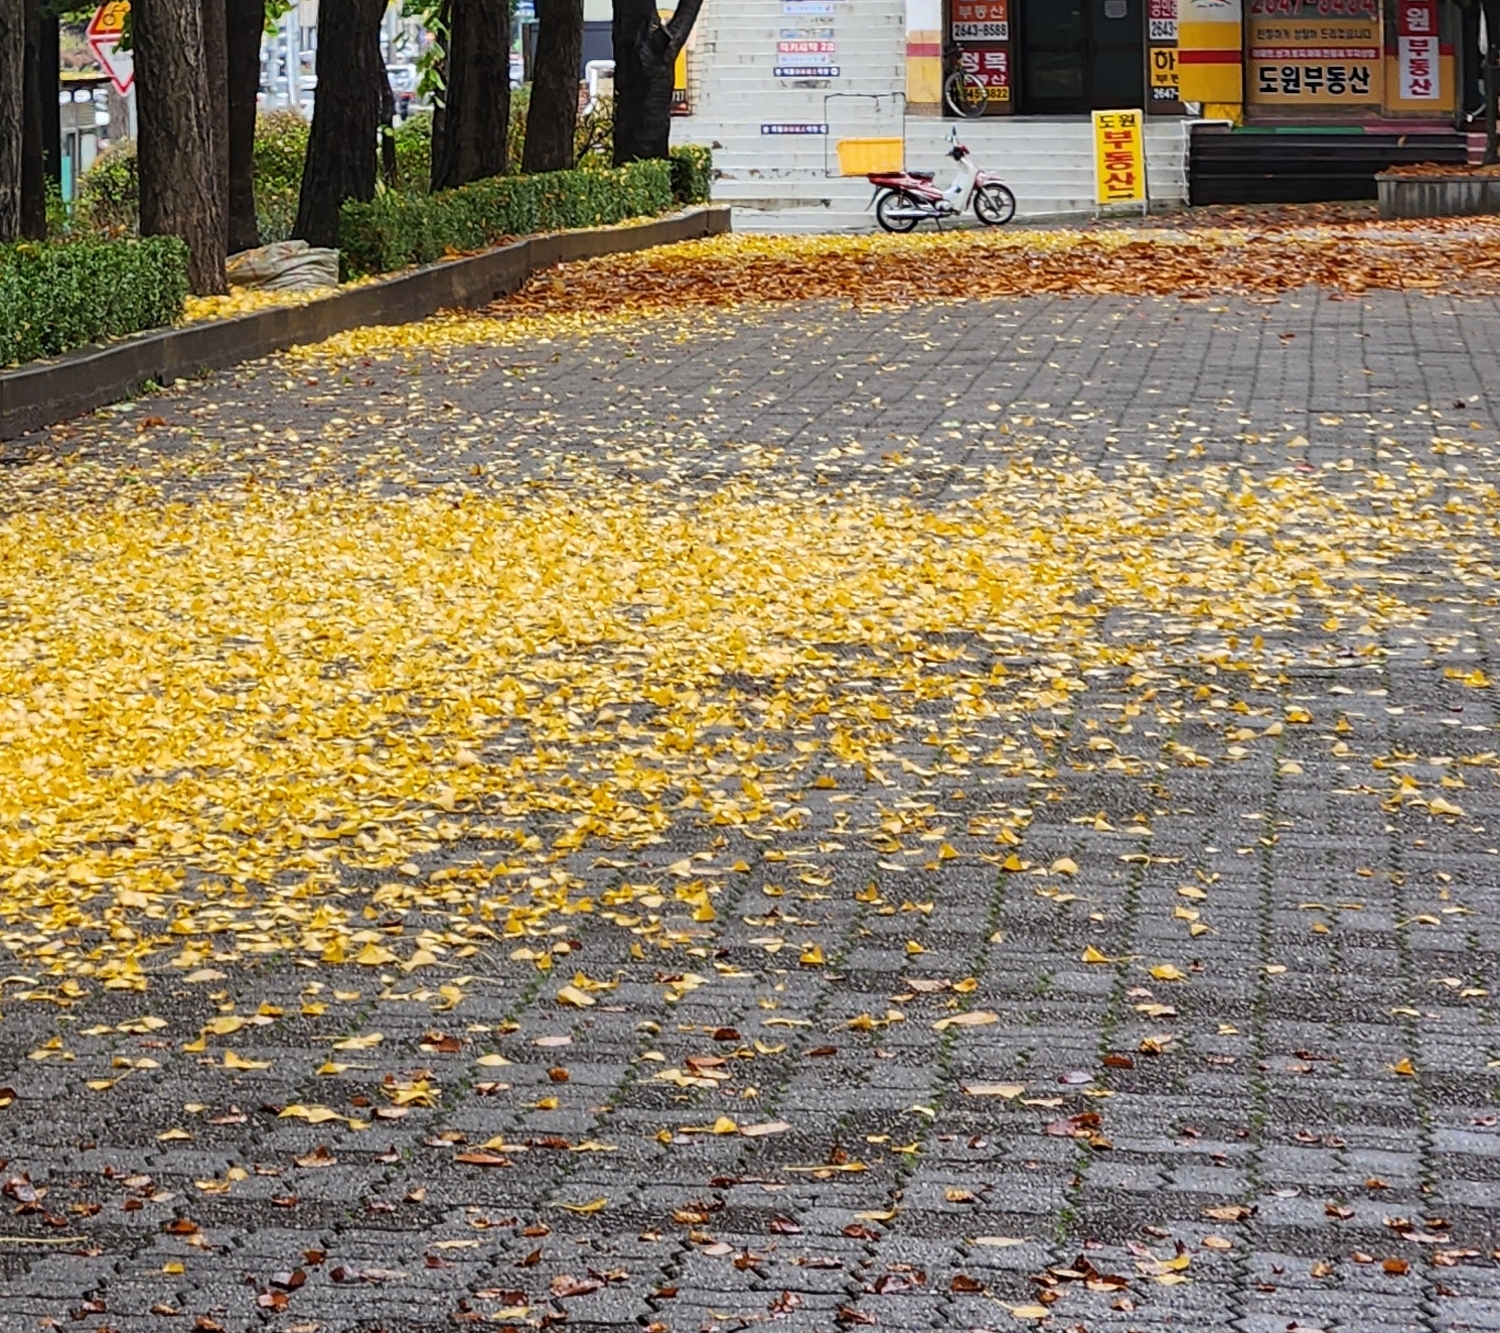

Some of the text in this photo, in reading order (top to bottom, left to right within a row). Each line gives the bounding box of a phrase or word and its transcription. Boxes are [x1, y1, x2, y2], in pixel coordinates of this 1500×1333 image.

[958, 5, 1005, 20] 부동산
[1258, 66, 1371, 95] 도원부동산
[1407, 38, 1433, 97] 부동산
[1098, 114, 1137, 129] 도원
[1102, 130, 1137, 192] 부동산
